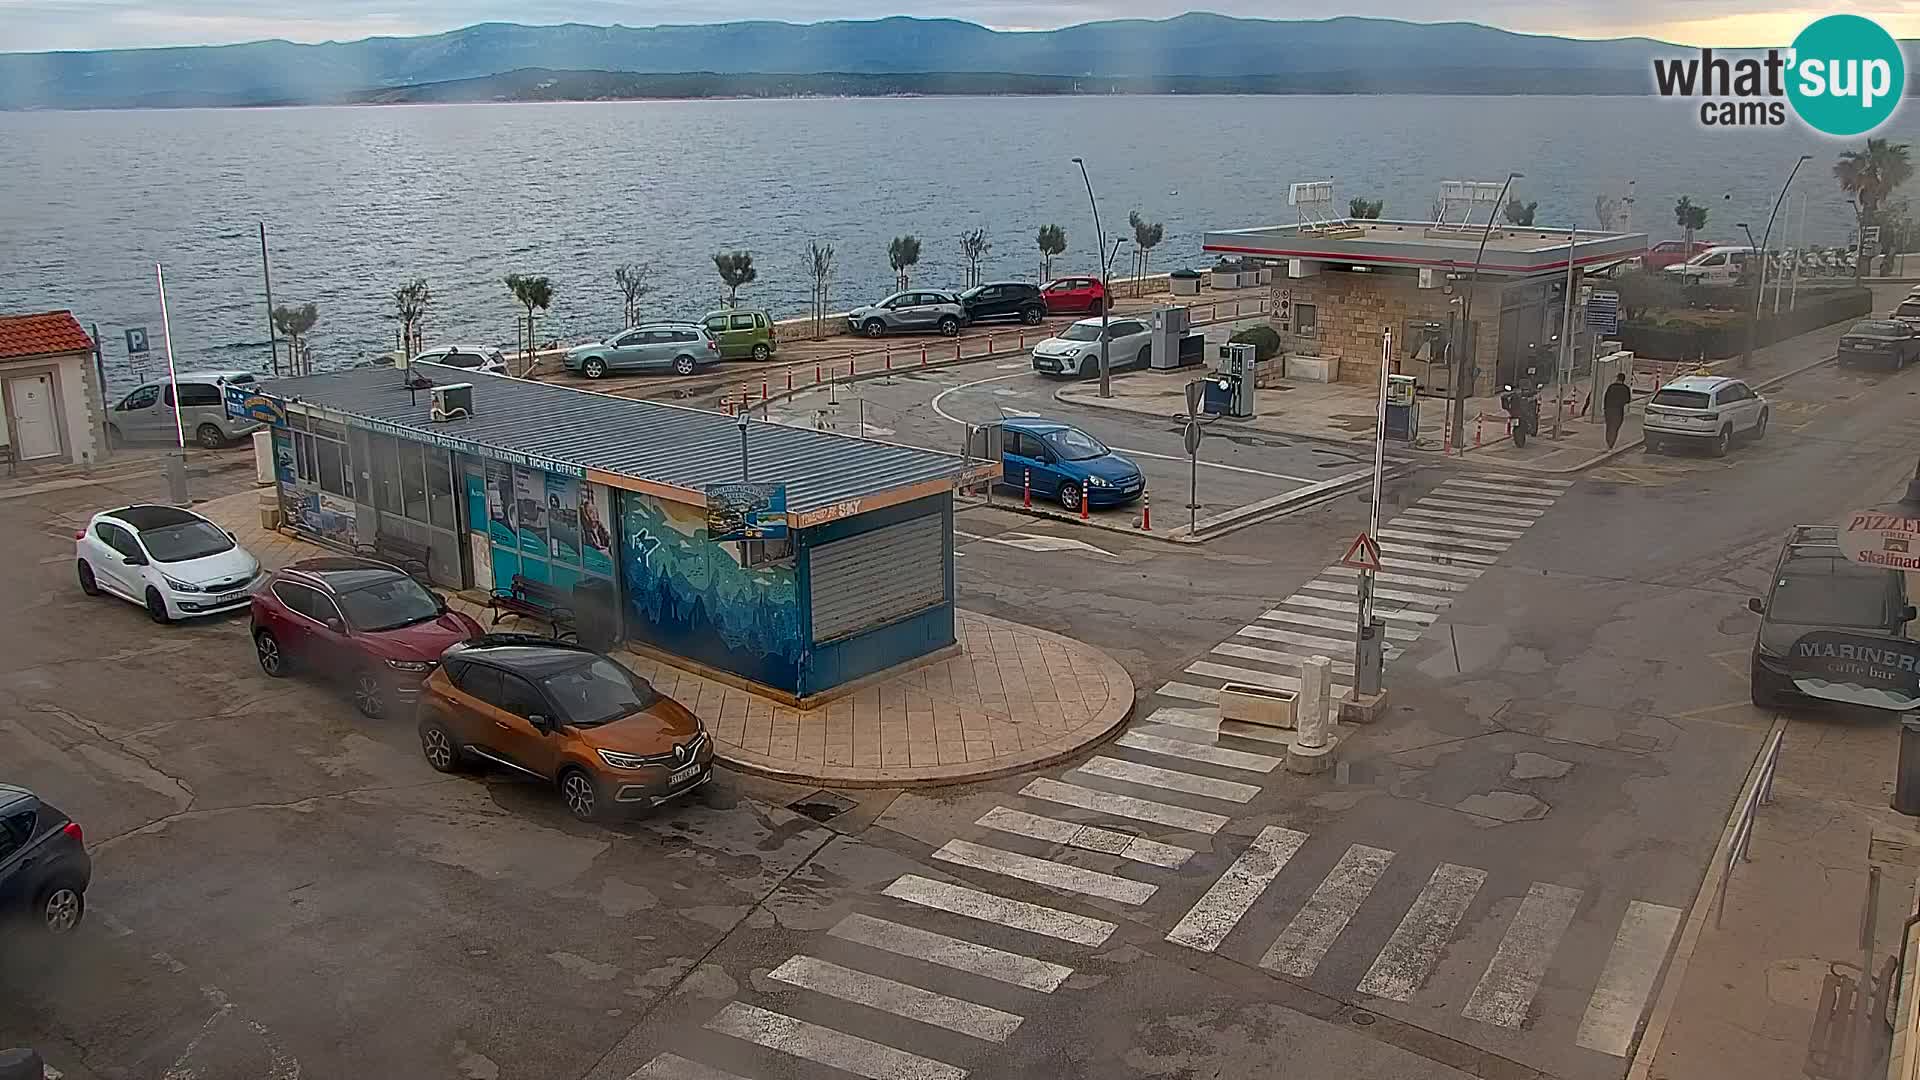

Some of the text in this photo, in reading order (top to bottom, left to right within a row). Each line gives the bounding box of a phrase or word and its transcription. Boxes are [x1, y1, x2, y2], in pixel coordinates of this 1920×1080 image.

[130, 331, 144, 350] P
[437, 438, 468, 453] POSTAJA
[478, 445, 494, 457] BUS
[495, 448, 527, 465] STATION
[528, 456, 555, 472] TICKET
[555, 463, 583, 477] OFFICE
[1847, 516, 1920, 534] PIZZE
[1869, 665, 1896, 680] bar
